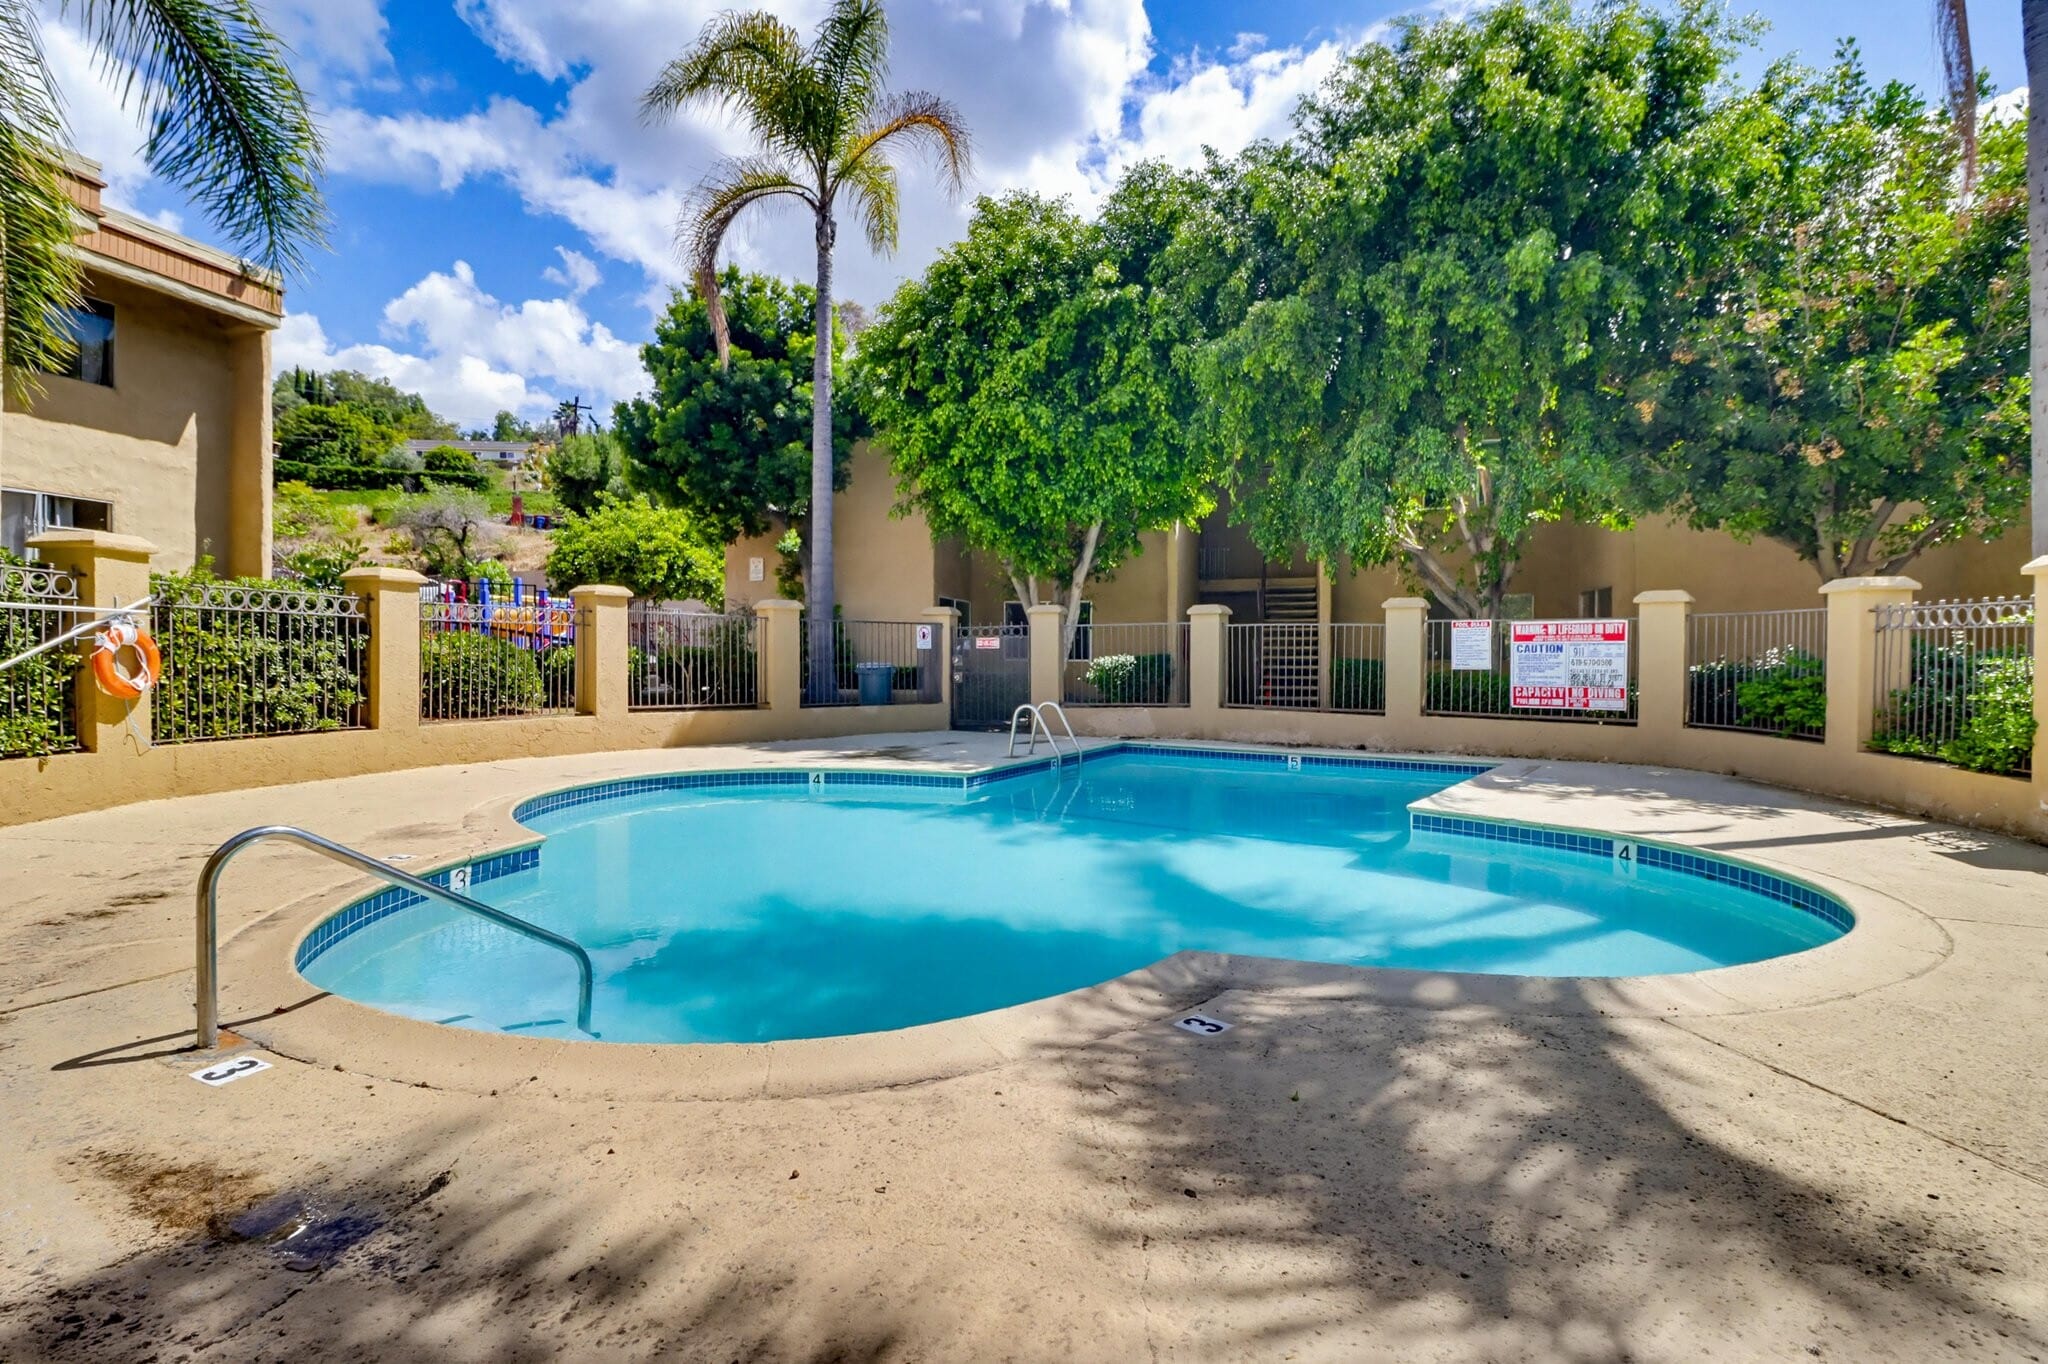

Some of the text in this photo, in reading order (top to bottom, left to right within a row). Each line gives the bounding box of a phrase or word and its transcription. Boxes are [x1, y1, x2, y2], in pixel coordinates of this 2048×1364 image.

[1547, 624, 1557, 635] NO
[1605, 623, 1623, 634] DUTY
[1516, 644, 1563, 653] CAUTION
[1573, 647, 1585, 657] 911
[1515, 687, 1621, 699] CAPACITY NO DIVING
[812, 773, 821, 784] 4
[1618, 845, 1631, 860] 4
[454, 869, 467, 889] 3
[1183, 1017, 1224, 1033] 3
[201, 1060, 258, 1082] 3
